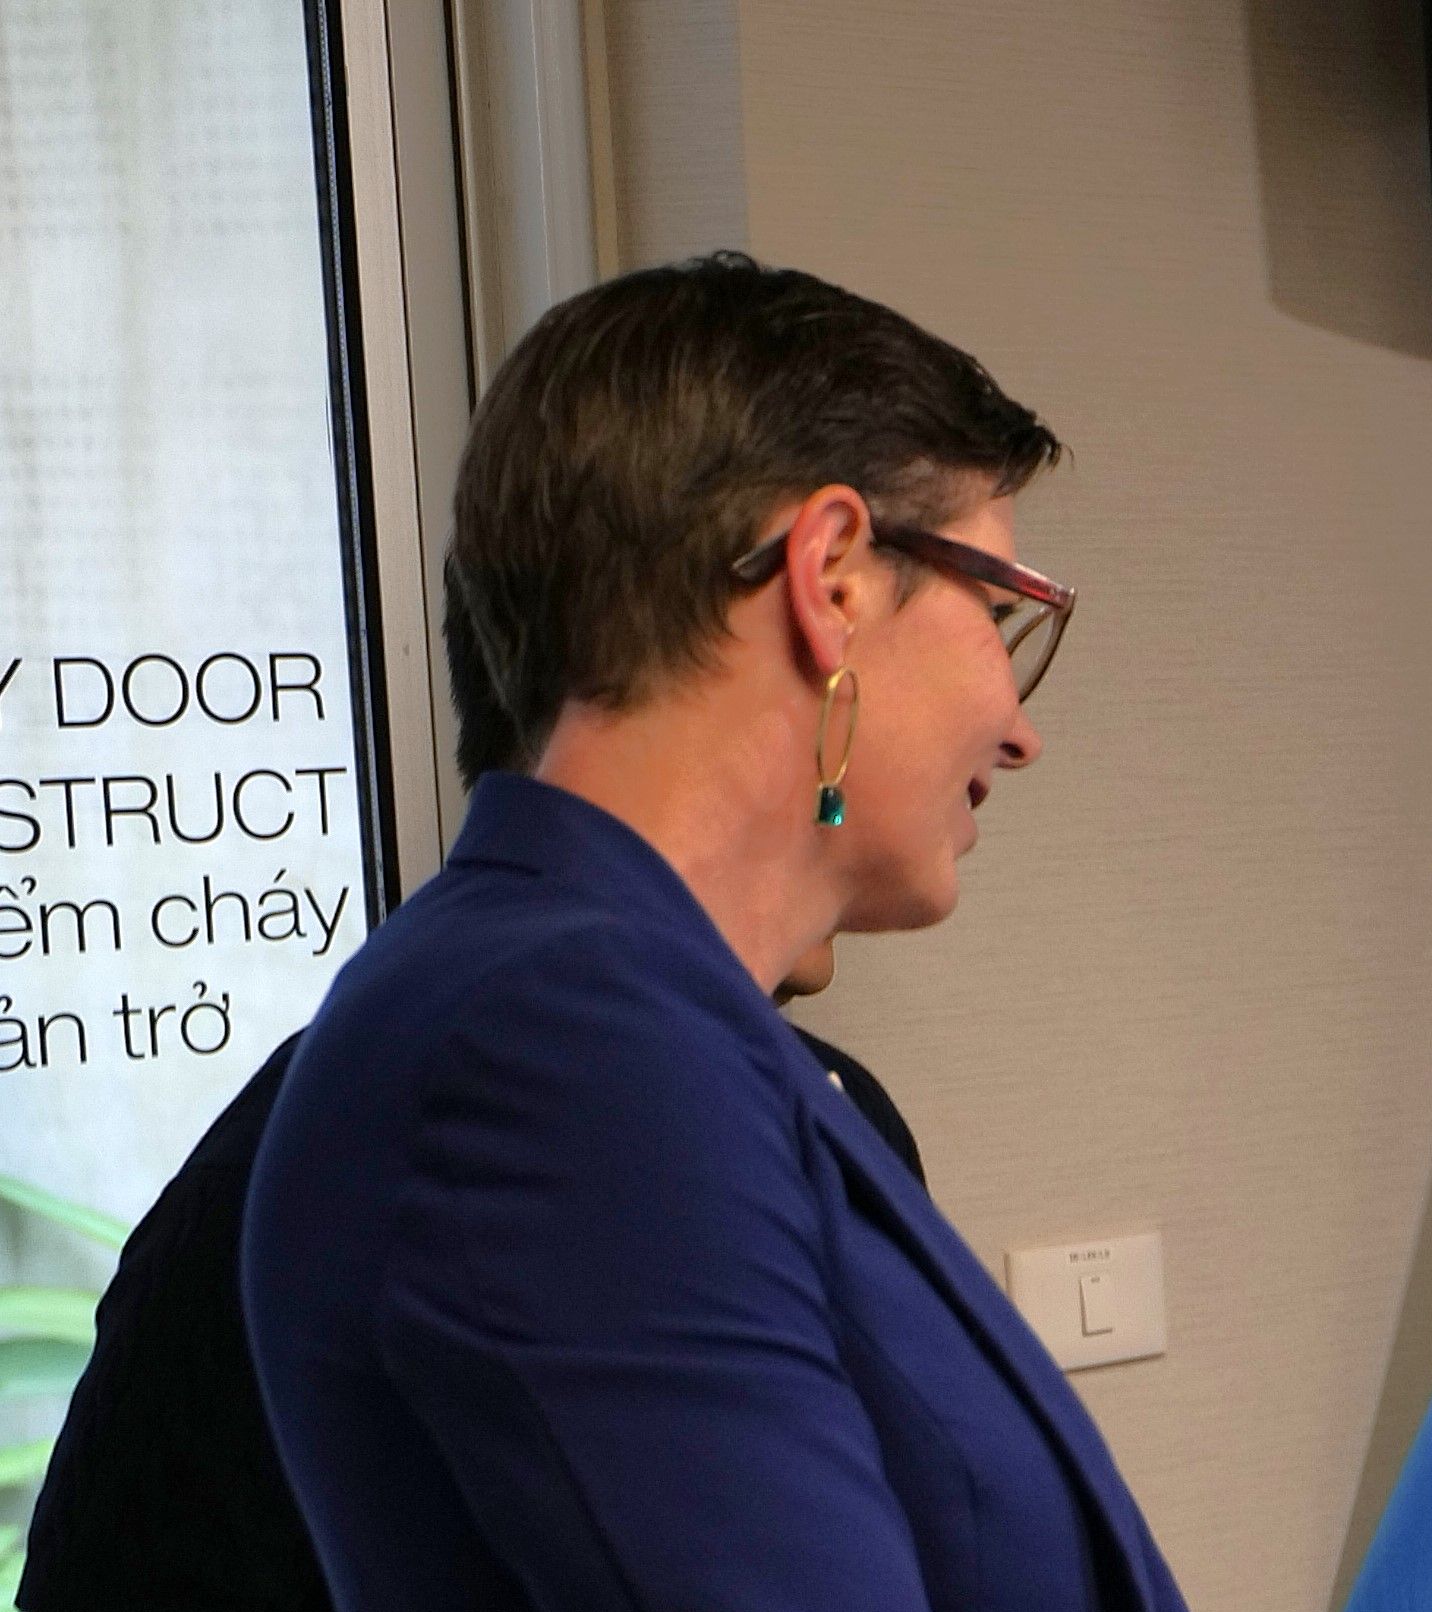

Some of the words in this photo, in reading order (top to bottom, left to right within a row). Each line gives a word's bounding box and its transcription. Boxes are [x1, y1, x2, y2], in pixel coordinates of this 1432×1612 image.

[54, 653, 324, 728] DOOR
[151, 868, 349, 956] cháy
[113, 982, 230, 1059] trở
